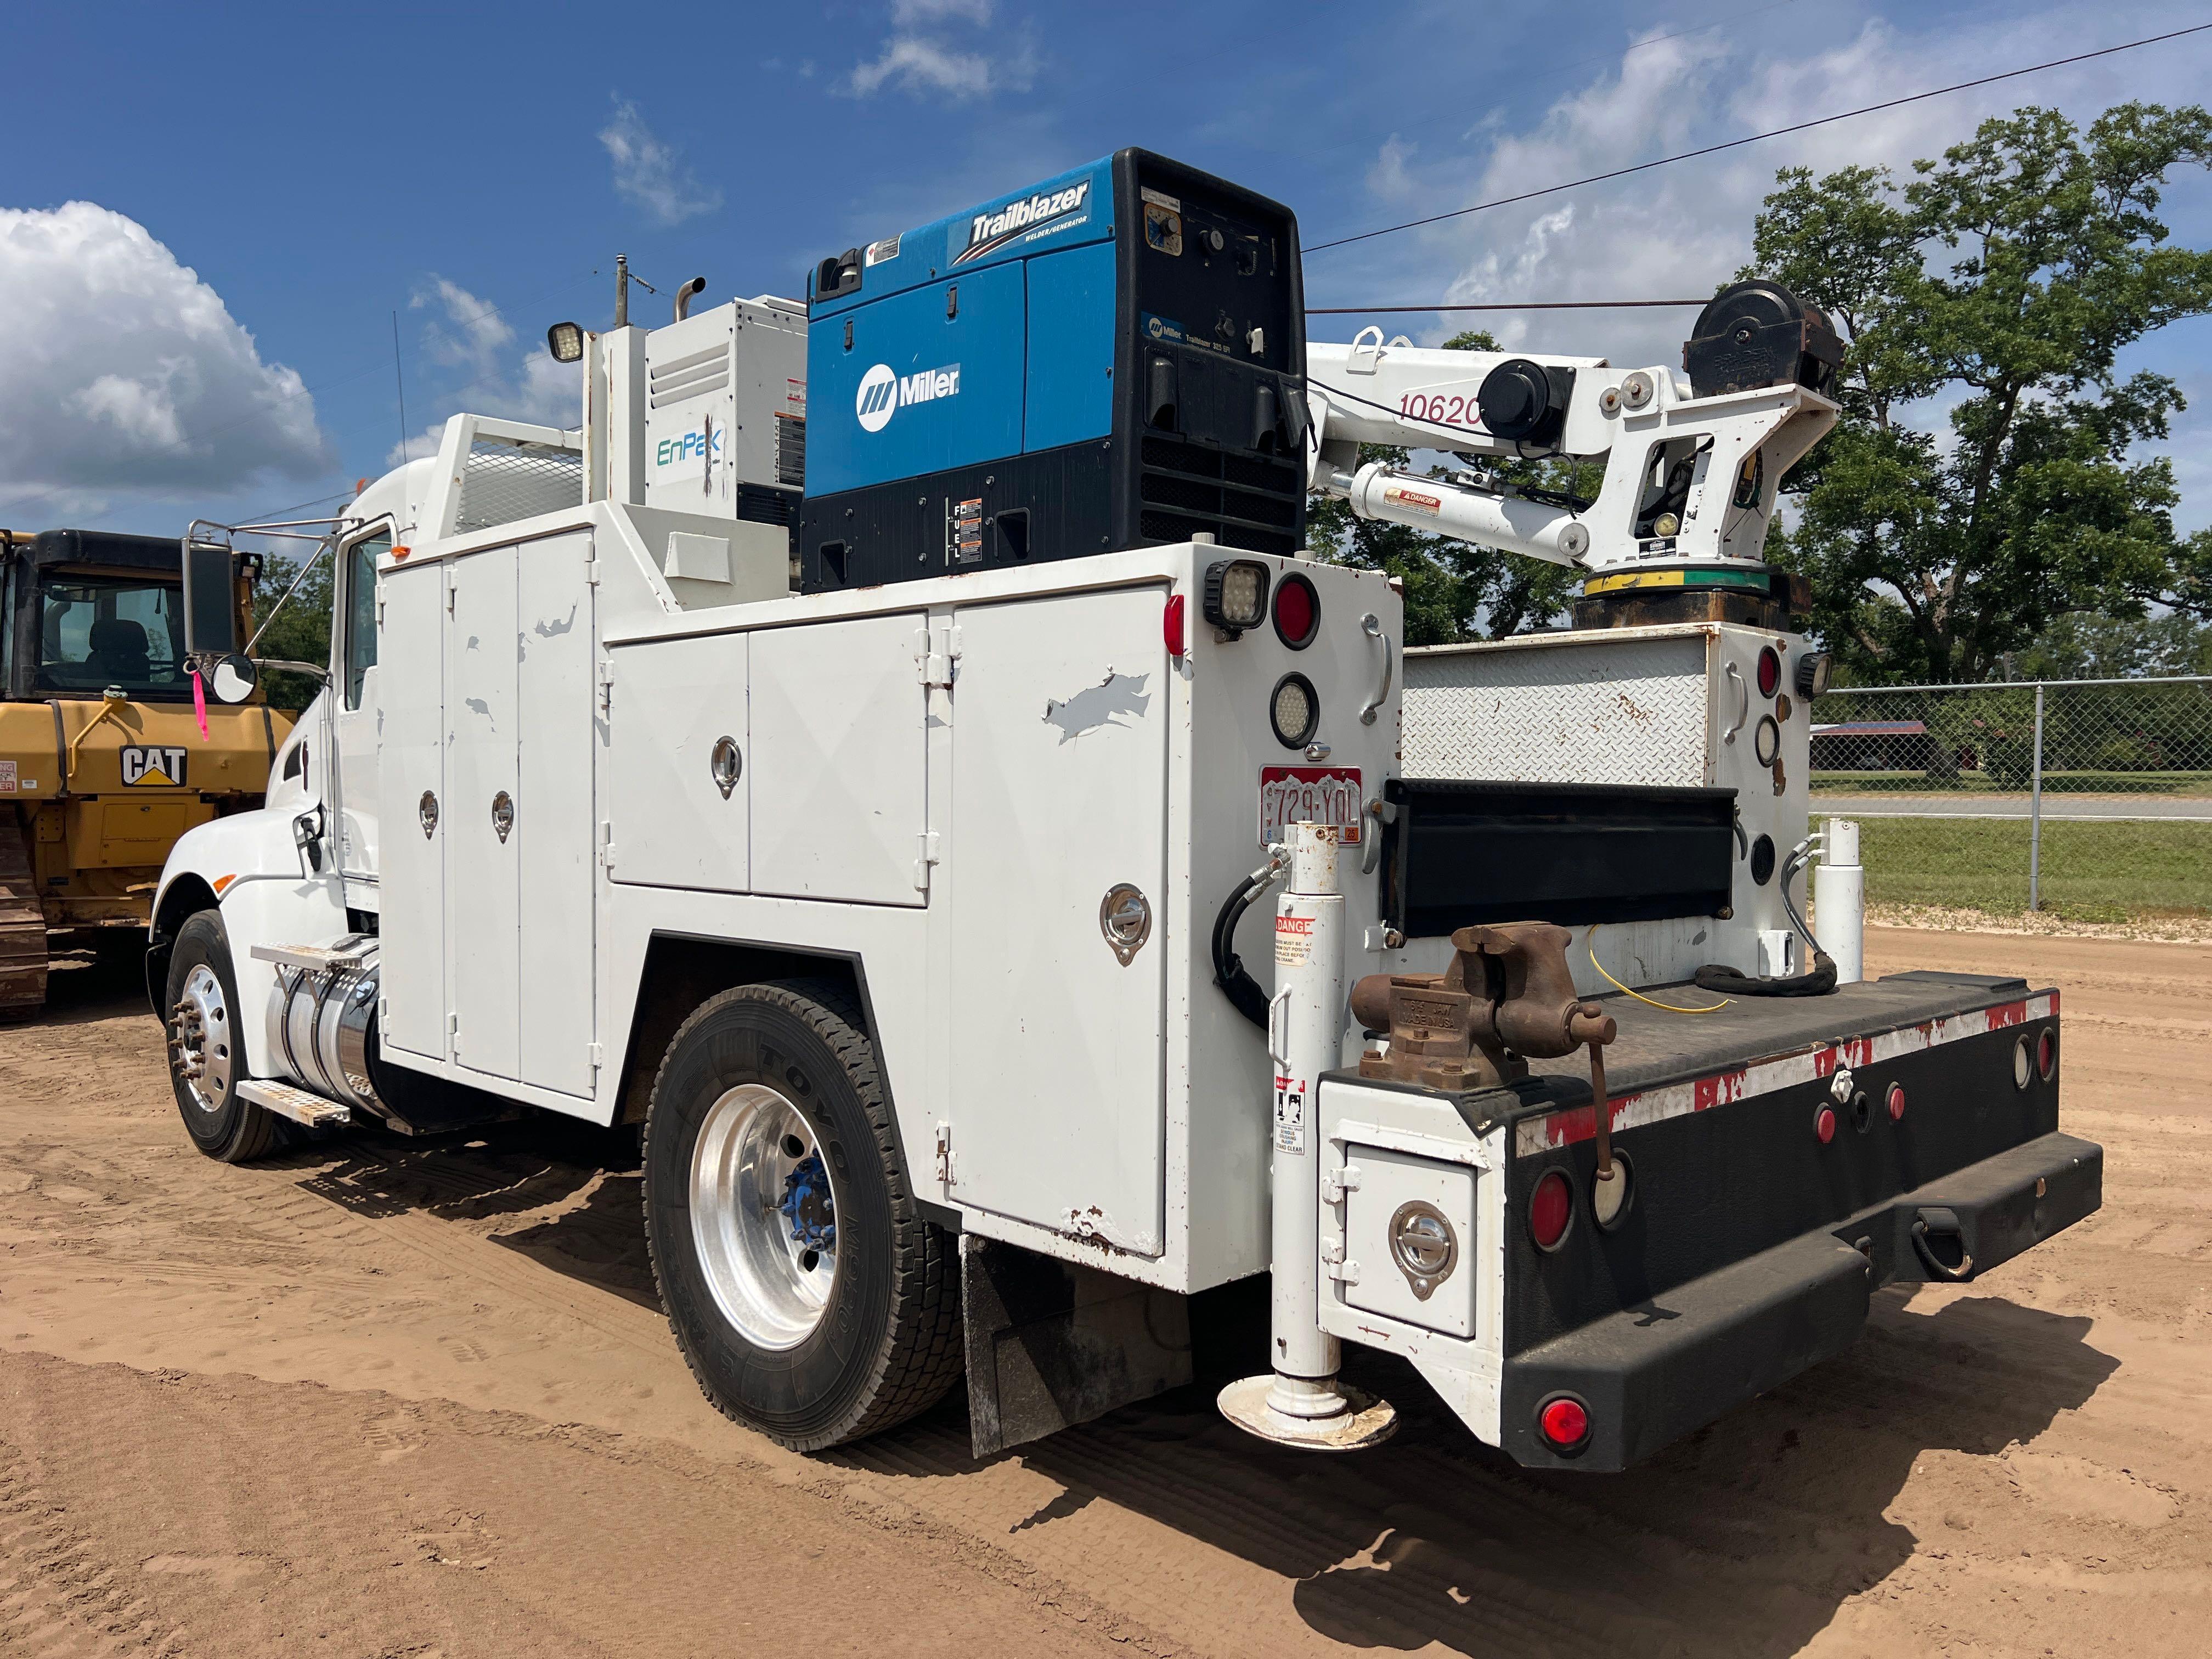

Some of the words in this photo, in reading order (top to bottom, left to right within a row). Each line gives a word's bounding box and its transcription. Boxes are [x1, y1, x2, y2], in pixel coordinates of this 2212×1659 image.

[973, 182, 1090, 243] Trailblazer
[1025, 216, 1087, 242] WELDER/GENERATOR
[1163, 326, 1181, 340] Miller
[900, 369, 959, 407] Miller
[1410, 493, 1437, 505] DANGER
[123, 748, 185, 785] CAT
[1347, 829, 1356, 838] 25
[1278, 918, 1311, 933] DANGE
[759, 1043, 851, 1184] TOYO
